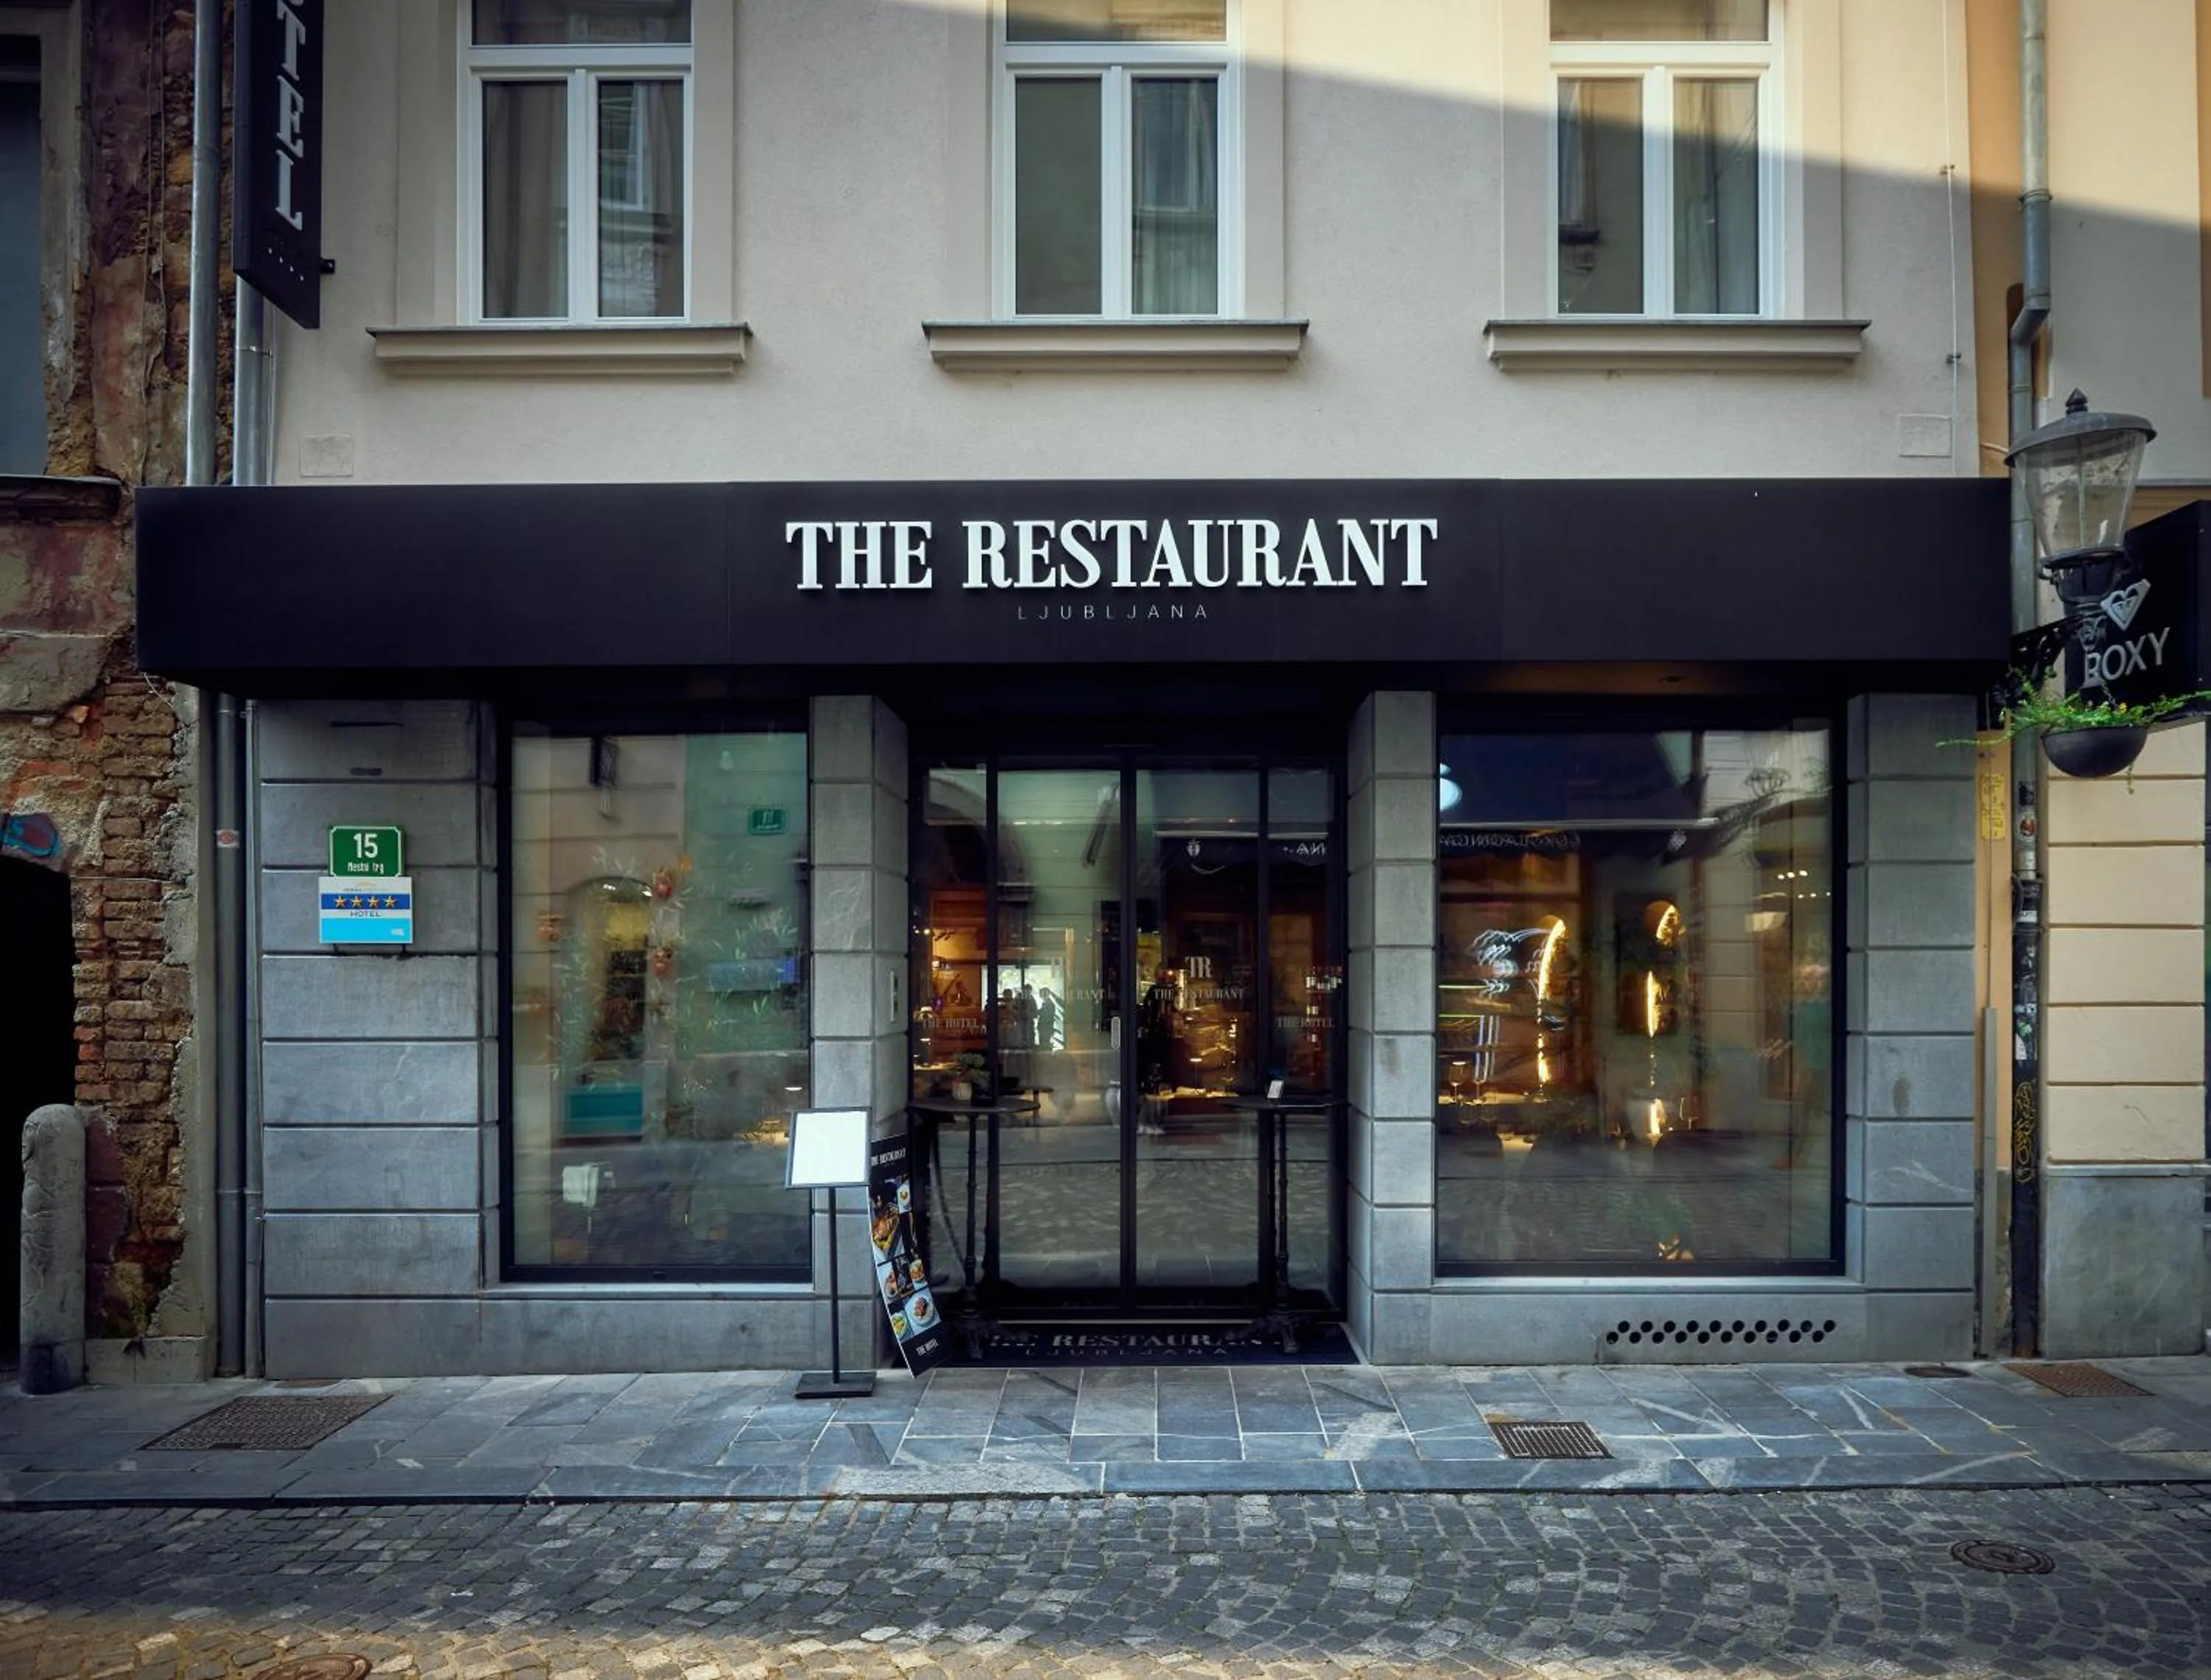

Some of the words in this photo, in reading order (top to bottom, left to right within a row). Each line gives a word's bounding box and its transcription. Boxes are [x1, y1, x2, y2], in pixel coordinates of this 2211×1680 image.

[276, 0, 306, 231] TEL
[785, 521, 933, 590] THE
[961, 518, 1439, 589] RESTAURANT
[1017, 604, 1207, 620] LJUBLJANA
[2085, 626, 2170, 681] ROXY
[353, 833, 378, 858] 15
[1184, 956, 1212, 979] TR
[1153, 988, 1174, 1000] THE
